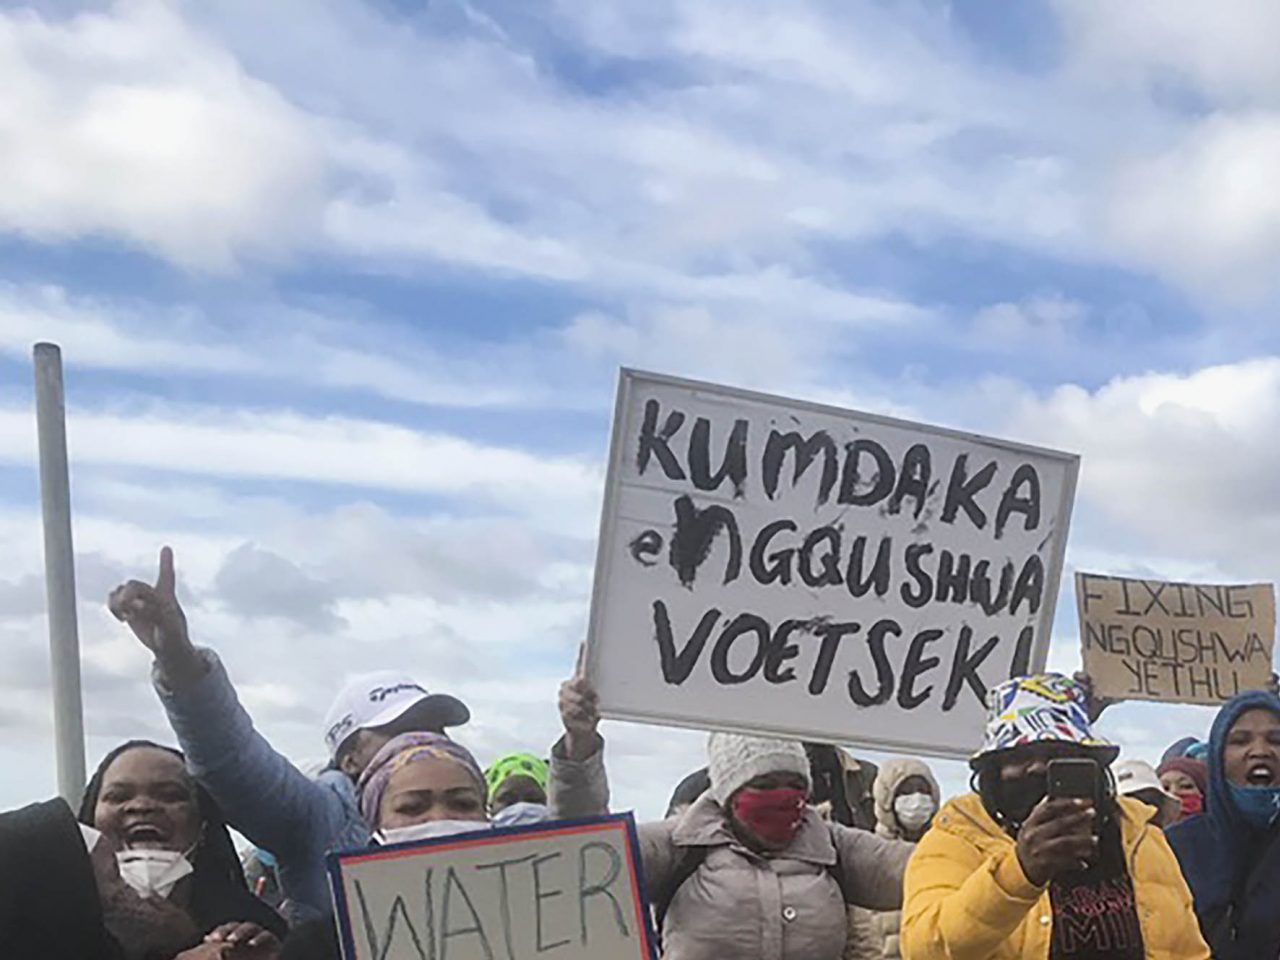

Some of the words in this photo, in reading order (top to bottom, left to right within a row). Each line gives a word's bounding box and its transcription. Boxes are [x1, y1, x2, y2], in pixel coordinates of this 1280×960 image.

[637, 399, 1041, 539] KUMDAKA
[1078, 573, 1254, 619] FIXING
[1085, 621, 1272, 665] NGQUSHWA
[1122, 658, 1240, 700] YETHU
